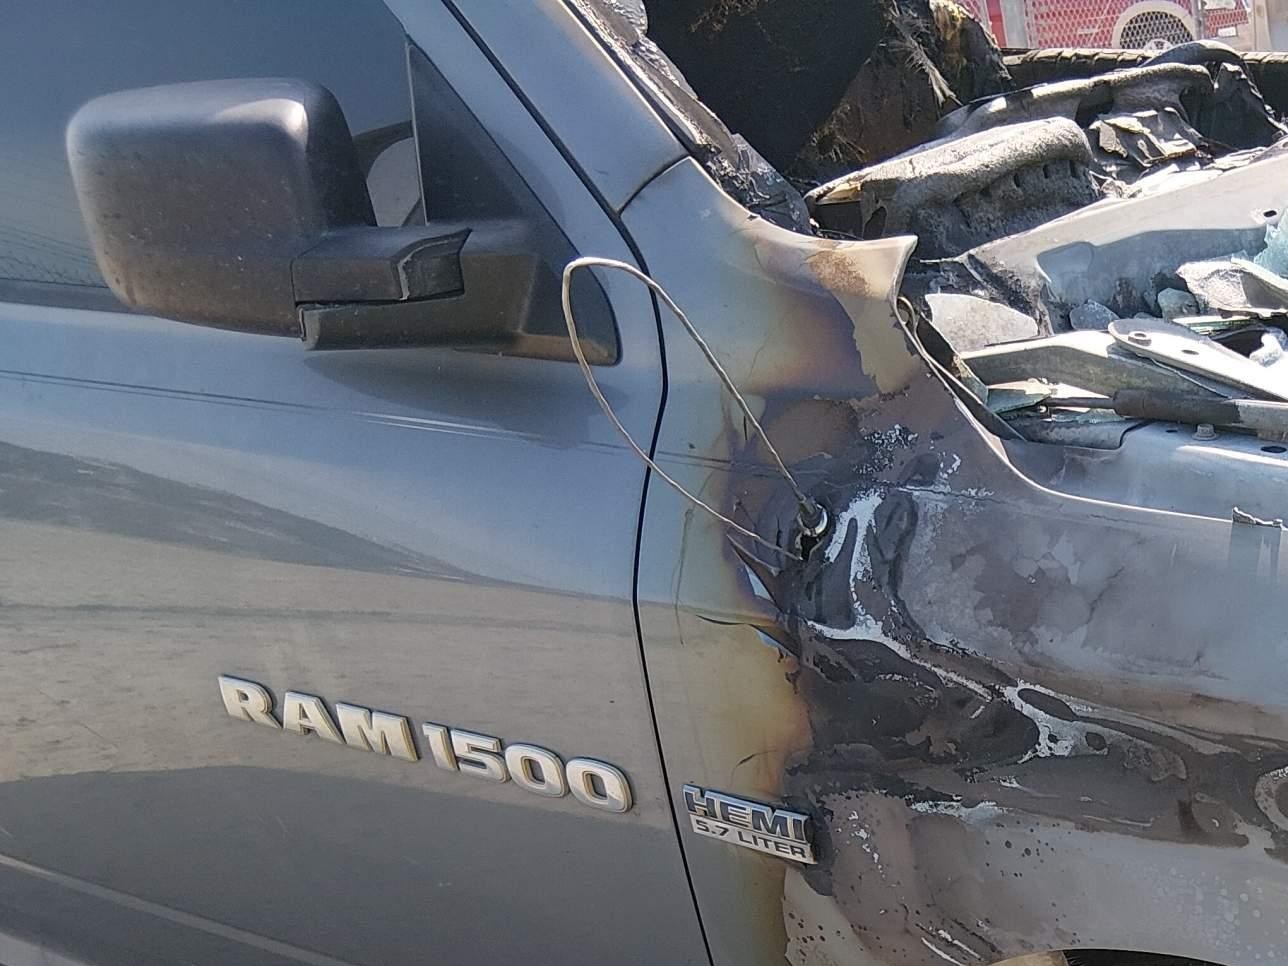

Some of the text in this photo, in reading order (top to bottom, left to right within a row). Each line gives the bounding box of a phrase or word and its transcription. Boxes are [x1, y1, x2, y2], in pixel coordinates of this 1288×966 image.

[218, 674, 633, 813] RAM 1500
[683, 784, 808, 841] HEMI
[695, 819, 807, 859] 5.7 LITER
